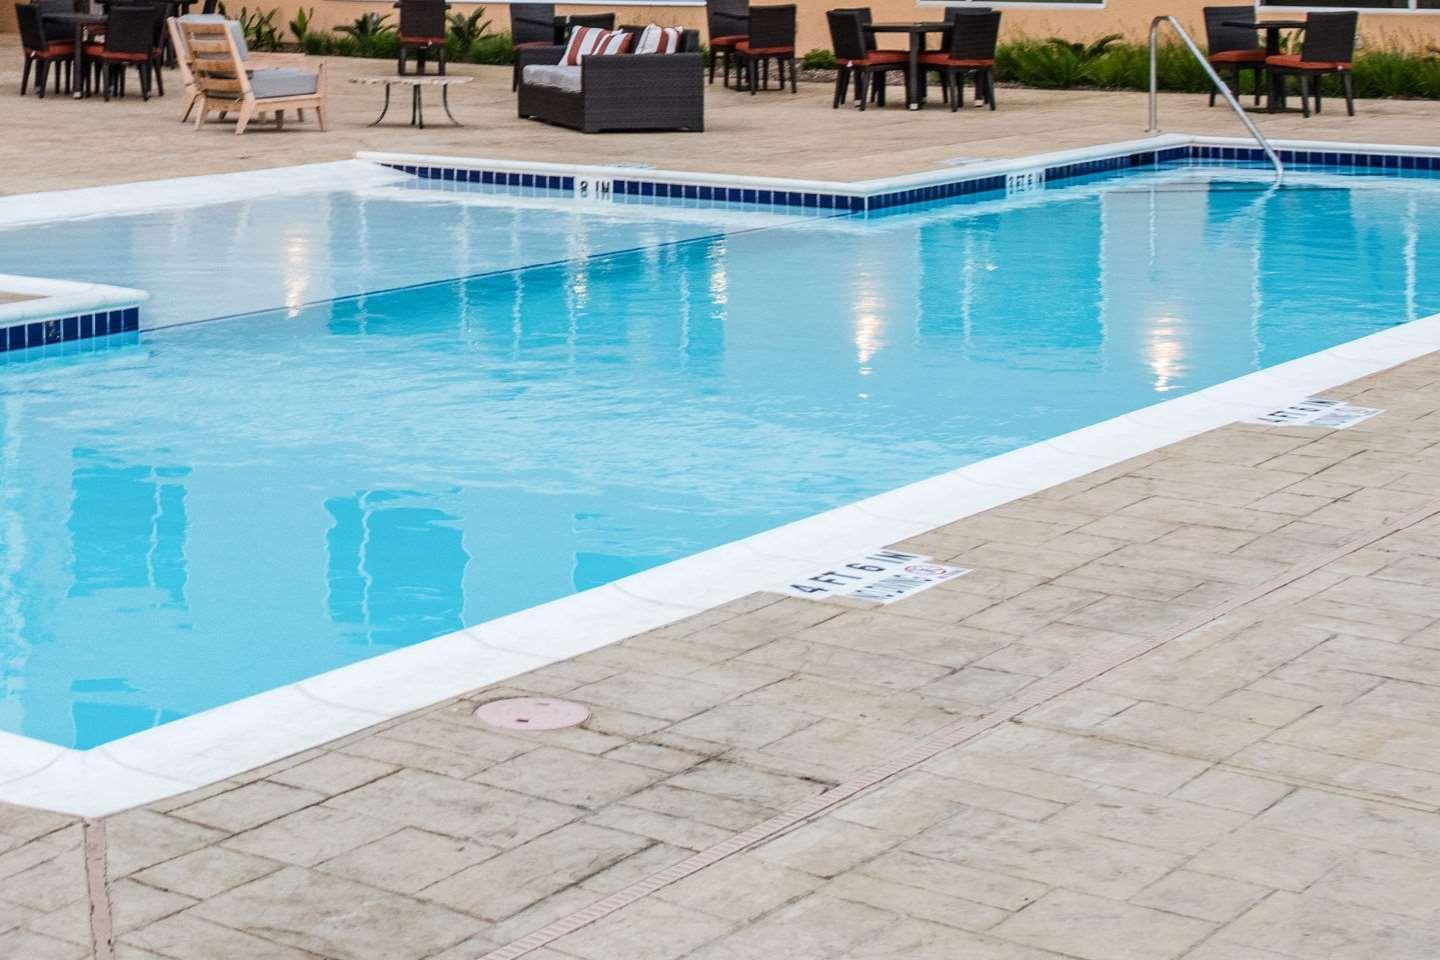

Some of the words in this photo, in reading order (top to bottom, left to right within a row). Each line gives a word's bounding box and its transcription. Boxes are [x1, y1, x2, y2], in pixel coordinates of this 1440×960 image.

[865, 550, 919, 565] IN
[845, 562, 886, 572] 6
[808, 571, 863, 586] FT
[789, 583, 828, 594] 4
